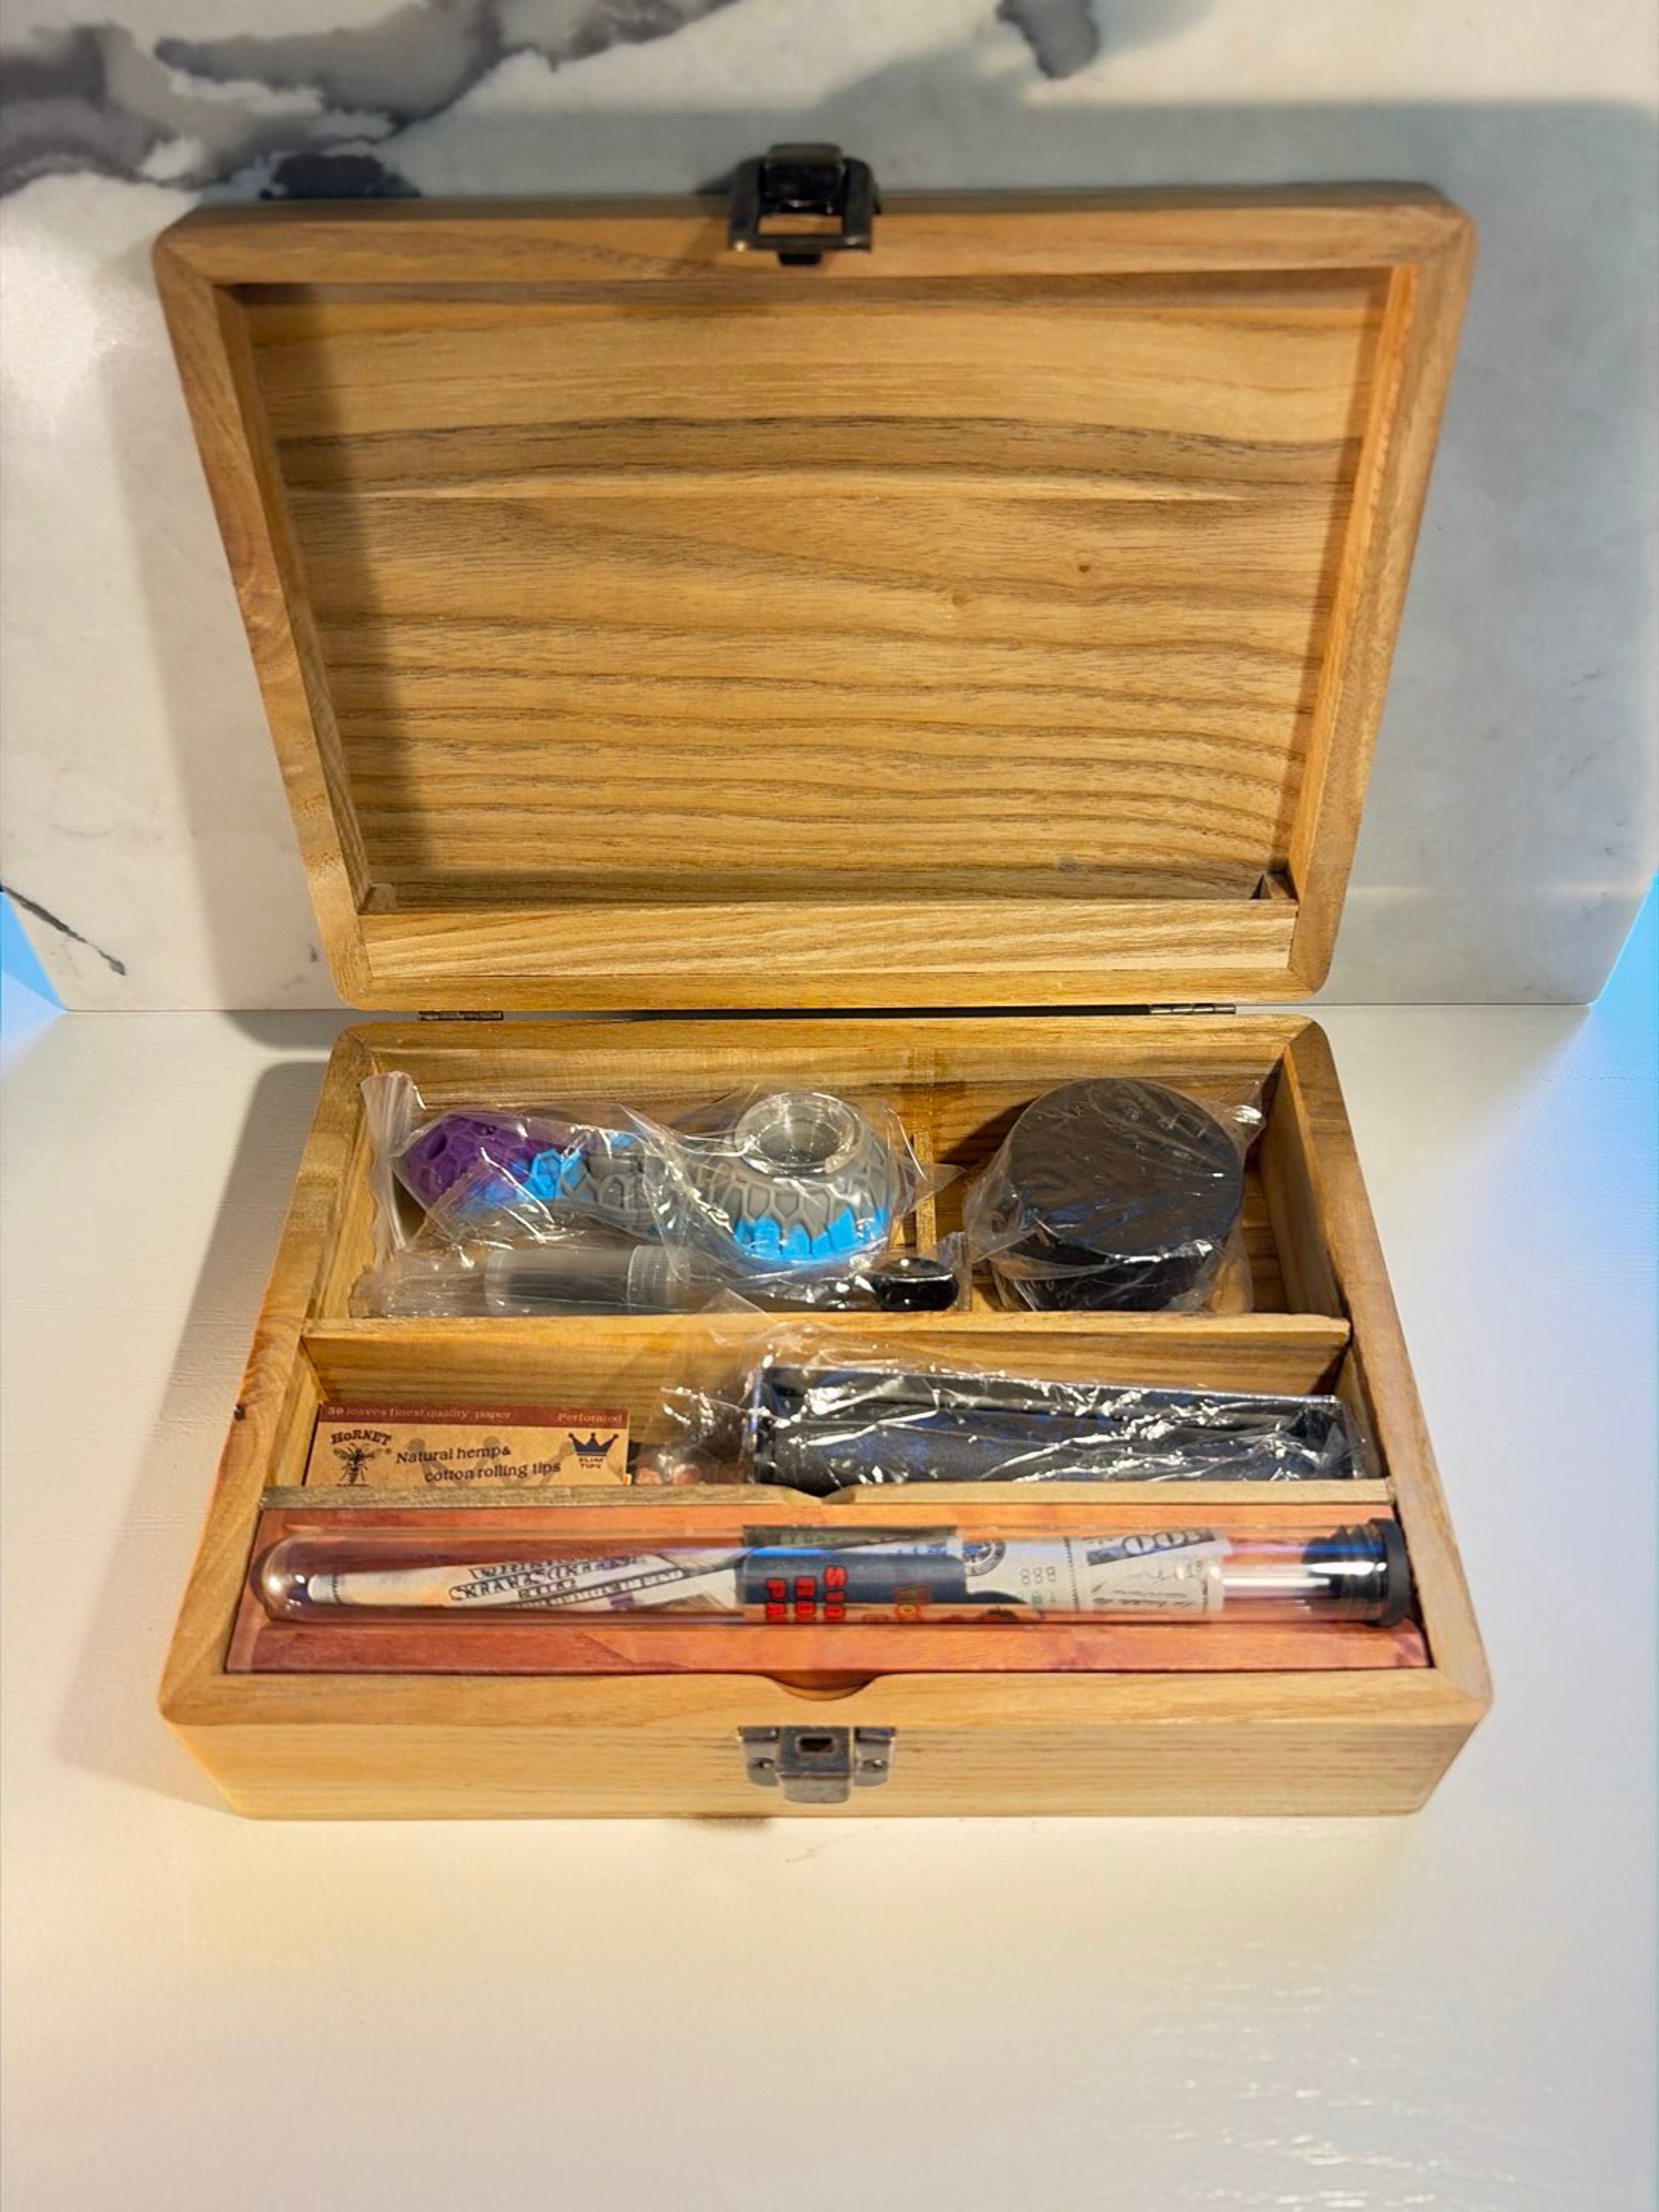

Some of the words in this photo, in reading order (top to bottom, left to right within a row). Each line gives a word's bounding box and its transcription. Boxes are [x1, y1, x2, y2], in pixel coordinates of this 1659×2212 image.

[426, 1409, 469, 1420] quality
[475, 1411, 511, 1420] paper
[558, 1412, 623, 1423] Perforated
[396, 1447, 453, 1464] Natural
[424, 1468, 475, 1483] cotton
[478, 1463, 528, 1478] rolling
[532, 1462, 561, 1476] tips
